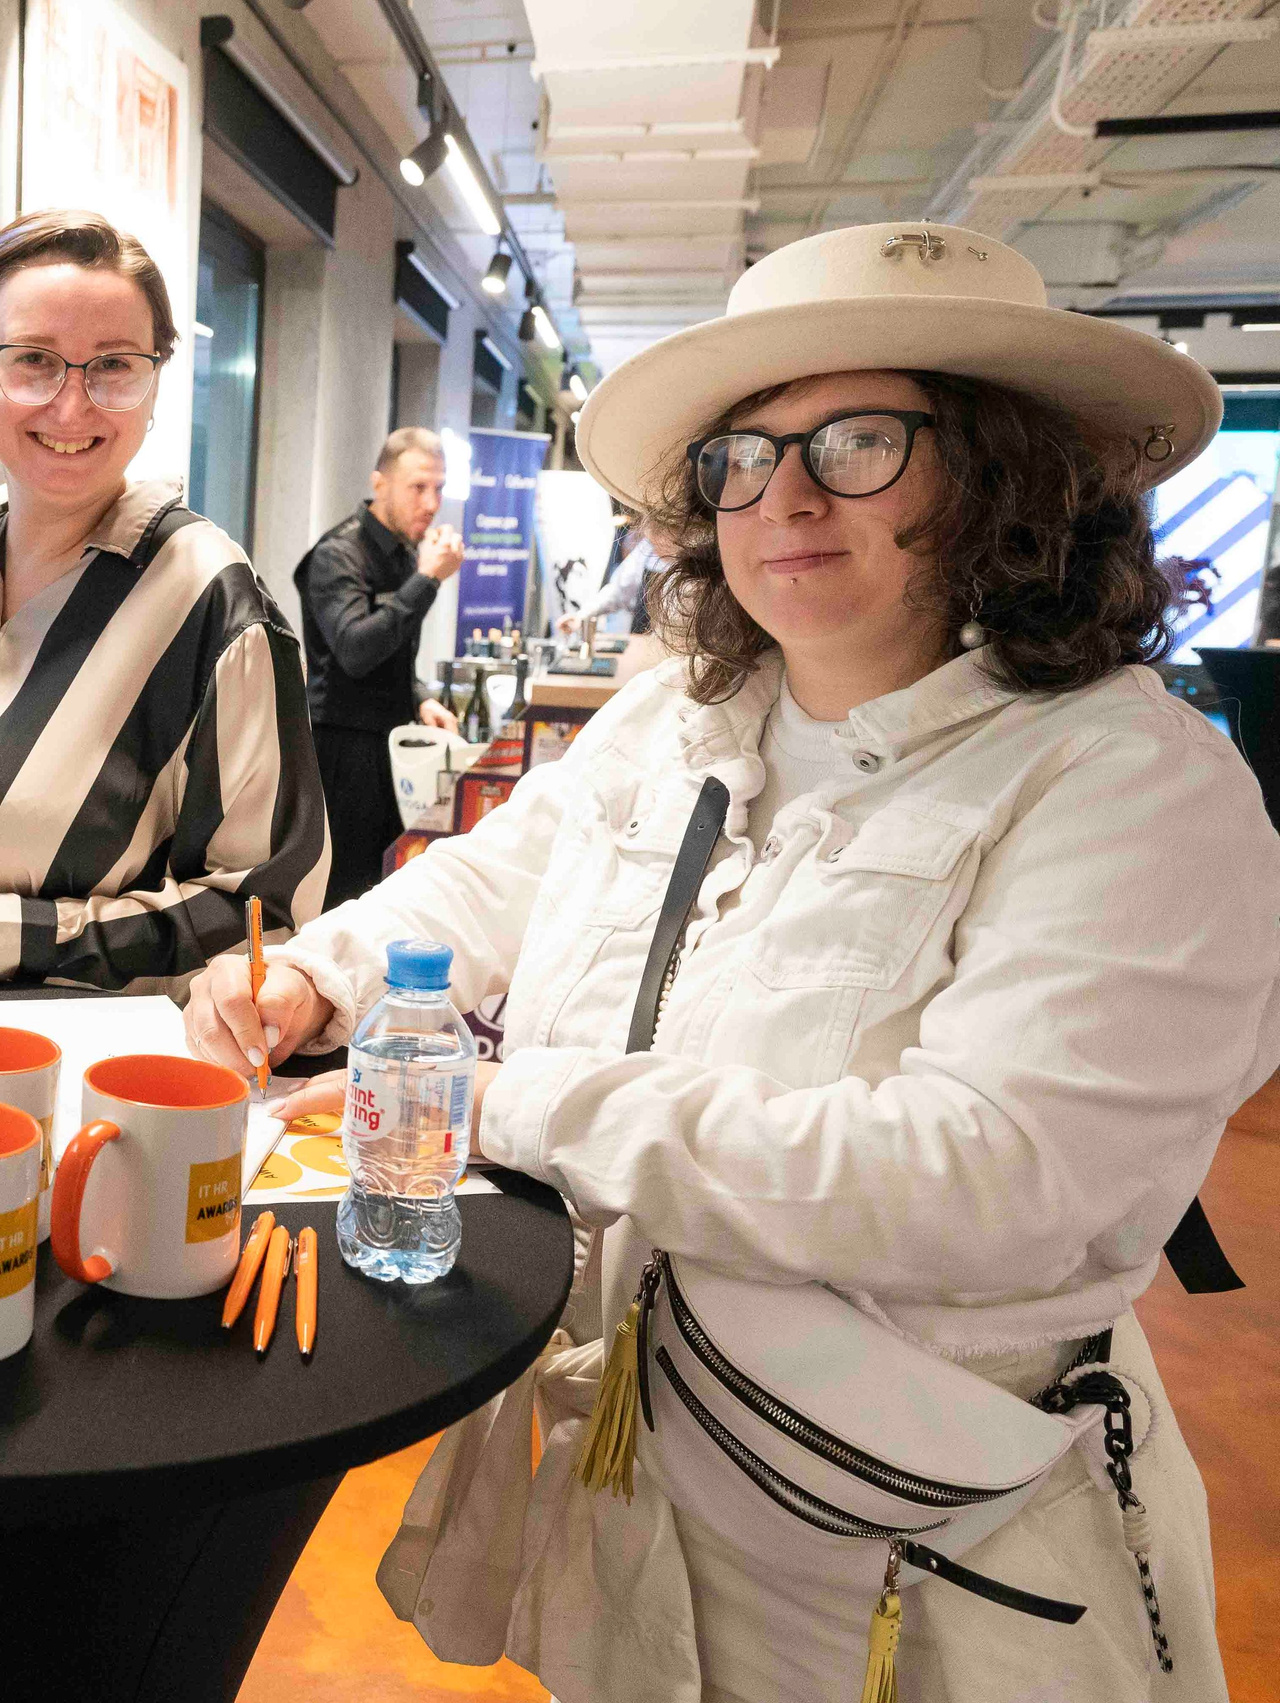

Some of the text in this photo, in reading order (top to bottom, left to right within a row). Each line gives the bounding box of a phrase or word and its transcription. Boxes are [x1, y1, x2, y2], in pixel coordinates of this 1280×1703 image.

[349, 1084, 375, 1108] aint
[349, 1102, 380, 1131] ring
[198, 1180, 228, 1199] IT HR
[9, 1231, 24, 1248] HR
